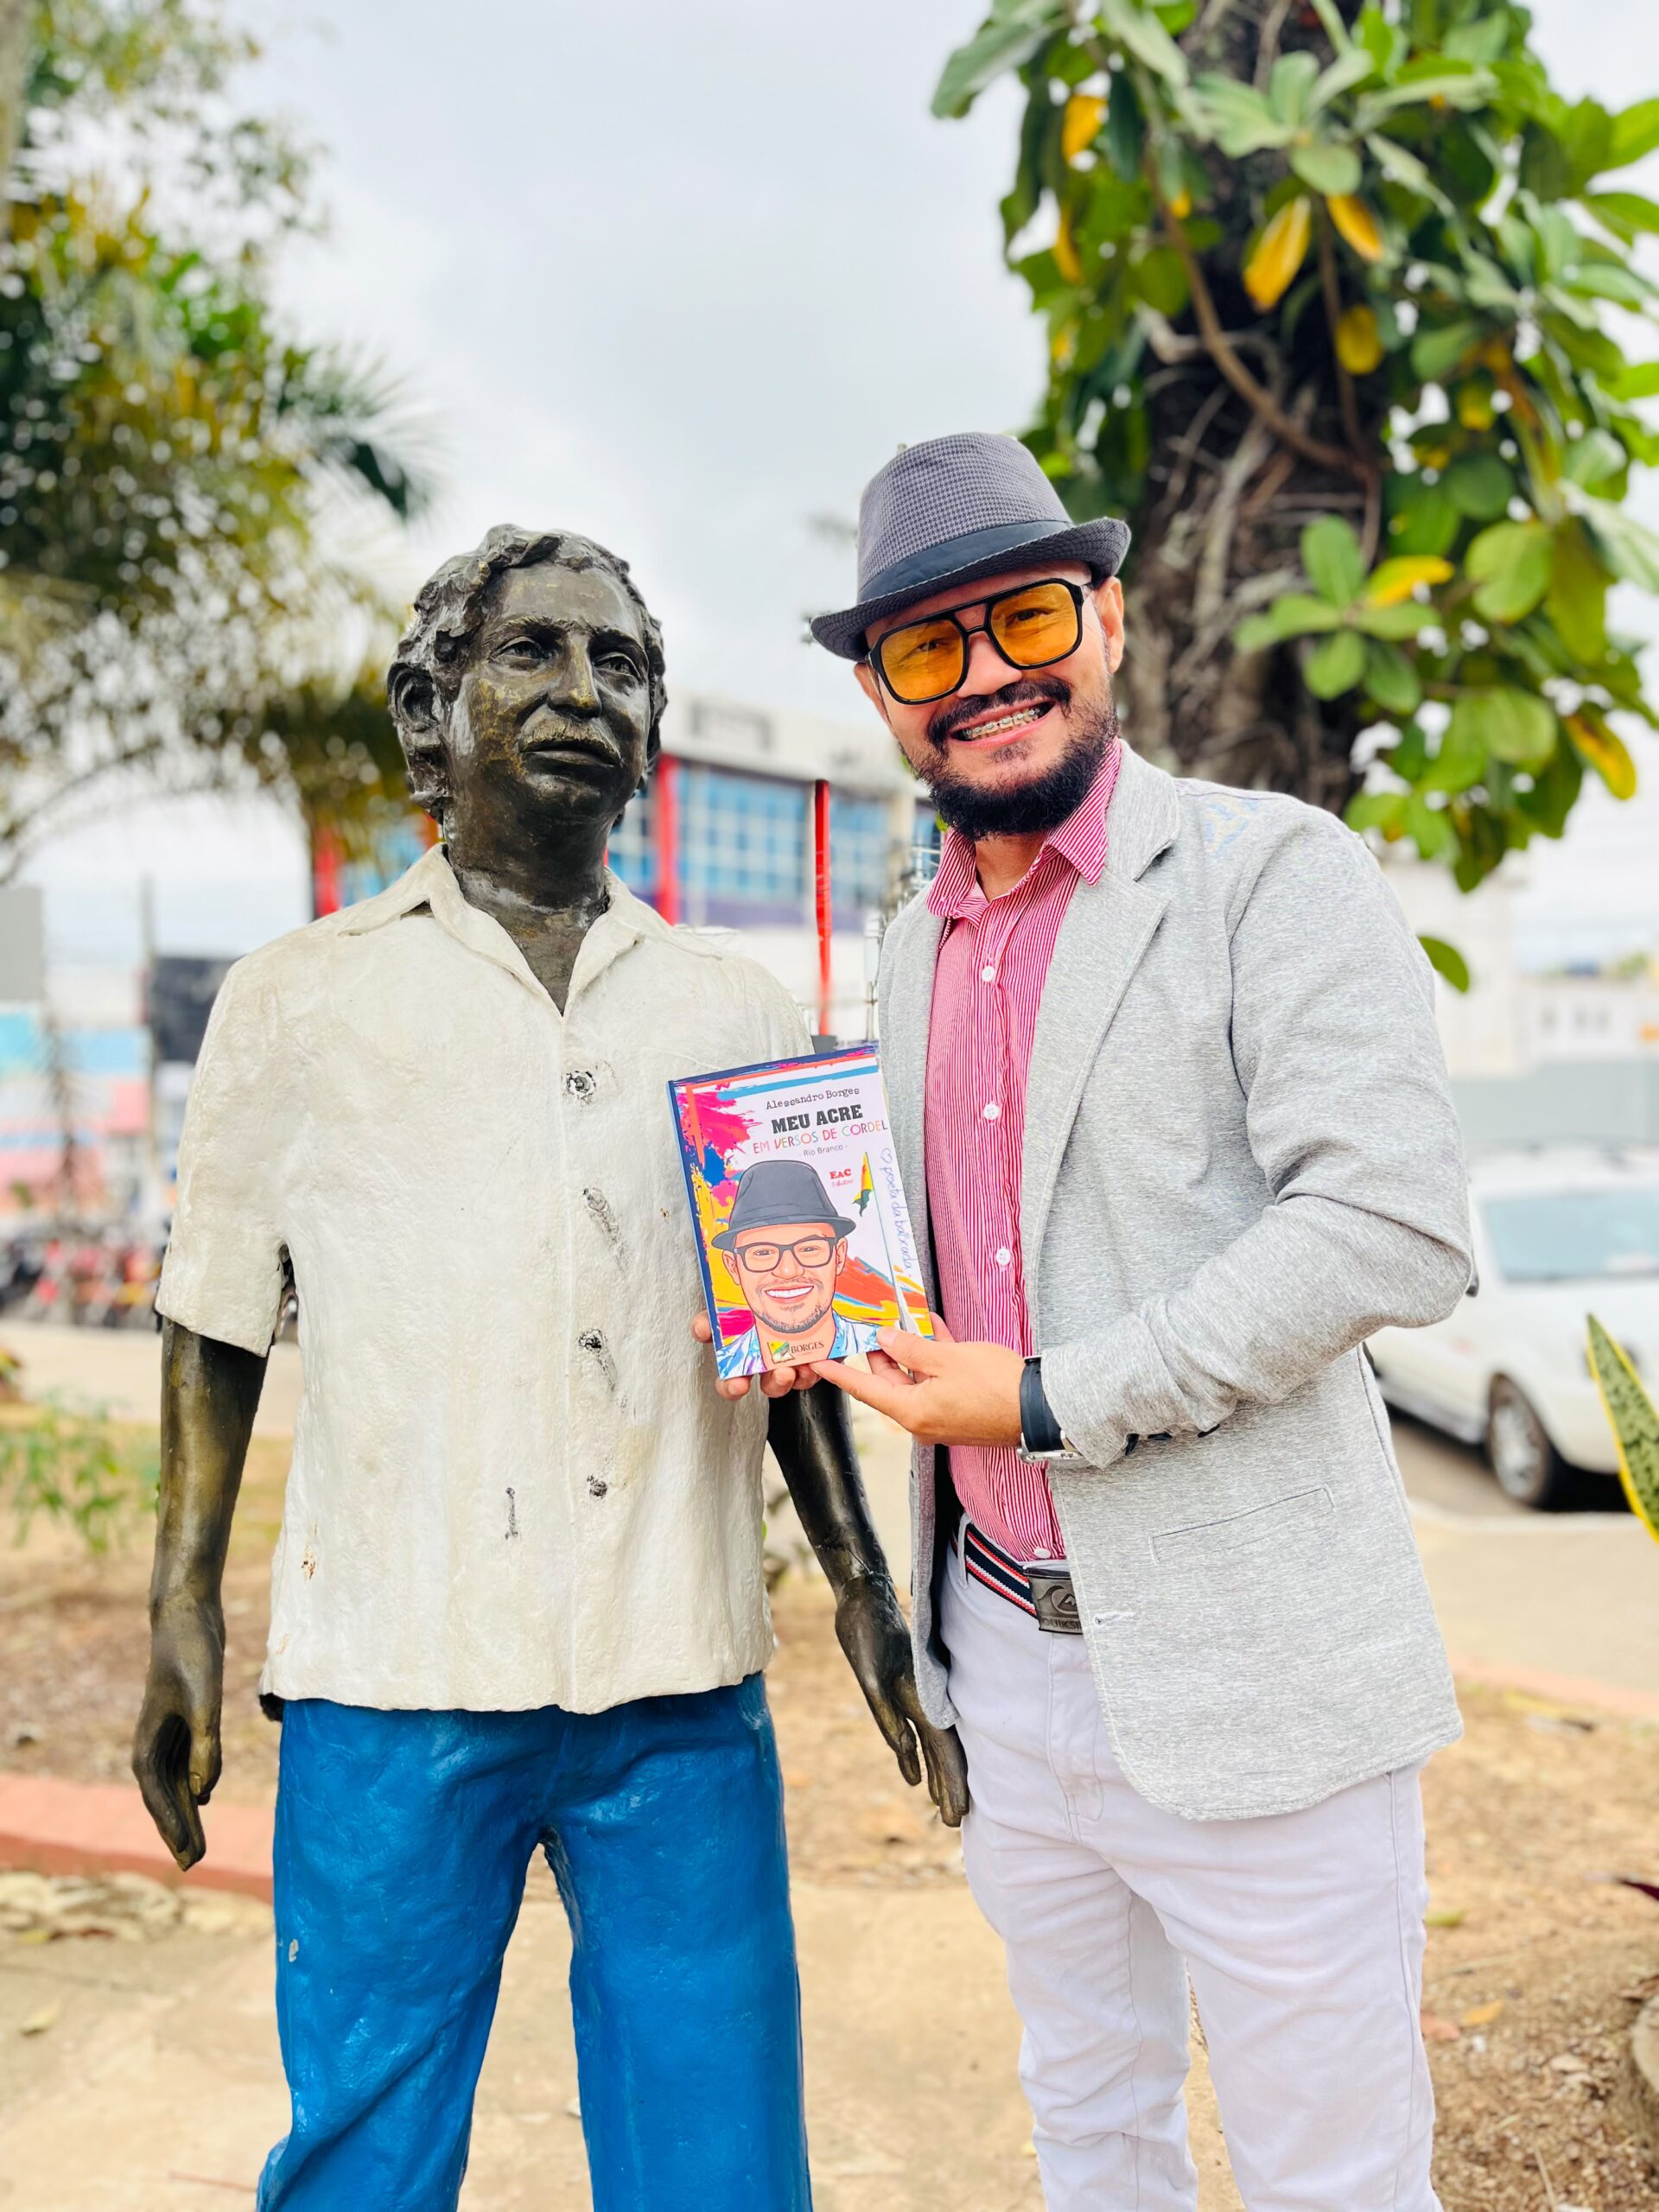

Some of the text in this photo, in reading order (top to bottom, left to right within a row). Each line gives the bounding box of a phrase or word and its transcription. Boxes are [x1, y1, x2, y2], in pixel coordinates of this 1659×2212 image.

[766, 1087, 861, 1110] Alessandro Borges
[771, 1104, 863, 1134] MEU ACRE
[753, 1120, 888, 1154] EM VERSOS DE CORDEL
[817, 1144, 844, 1154] Branco
[892, 1201, 909, 1217] da
[791, 1341, 824, 1354] BORGES
